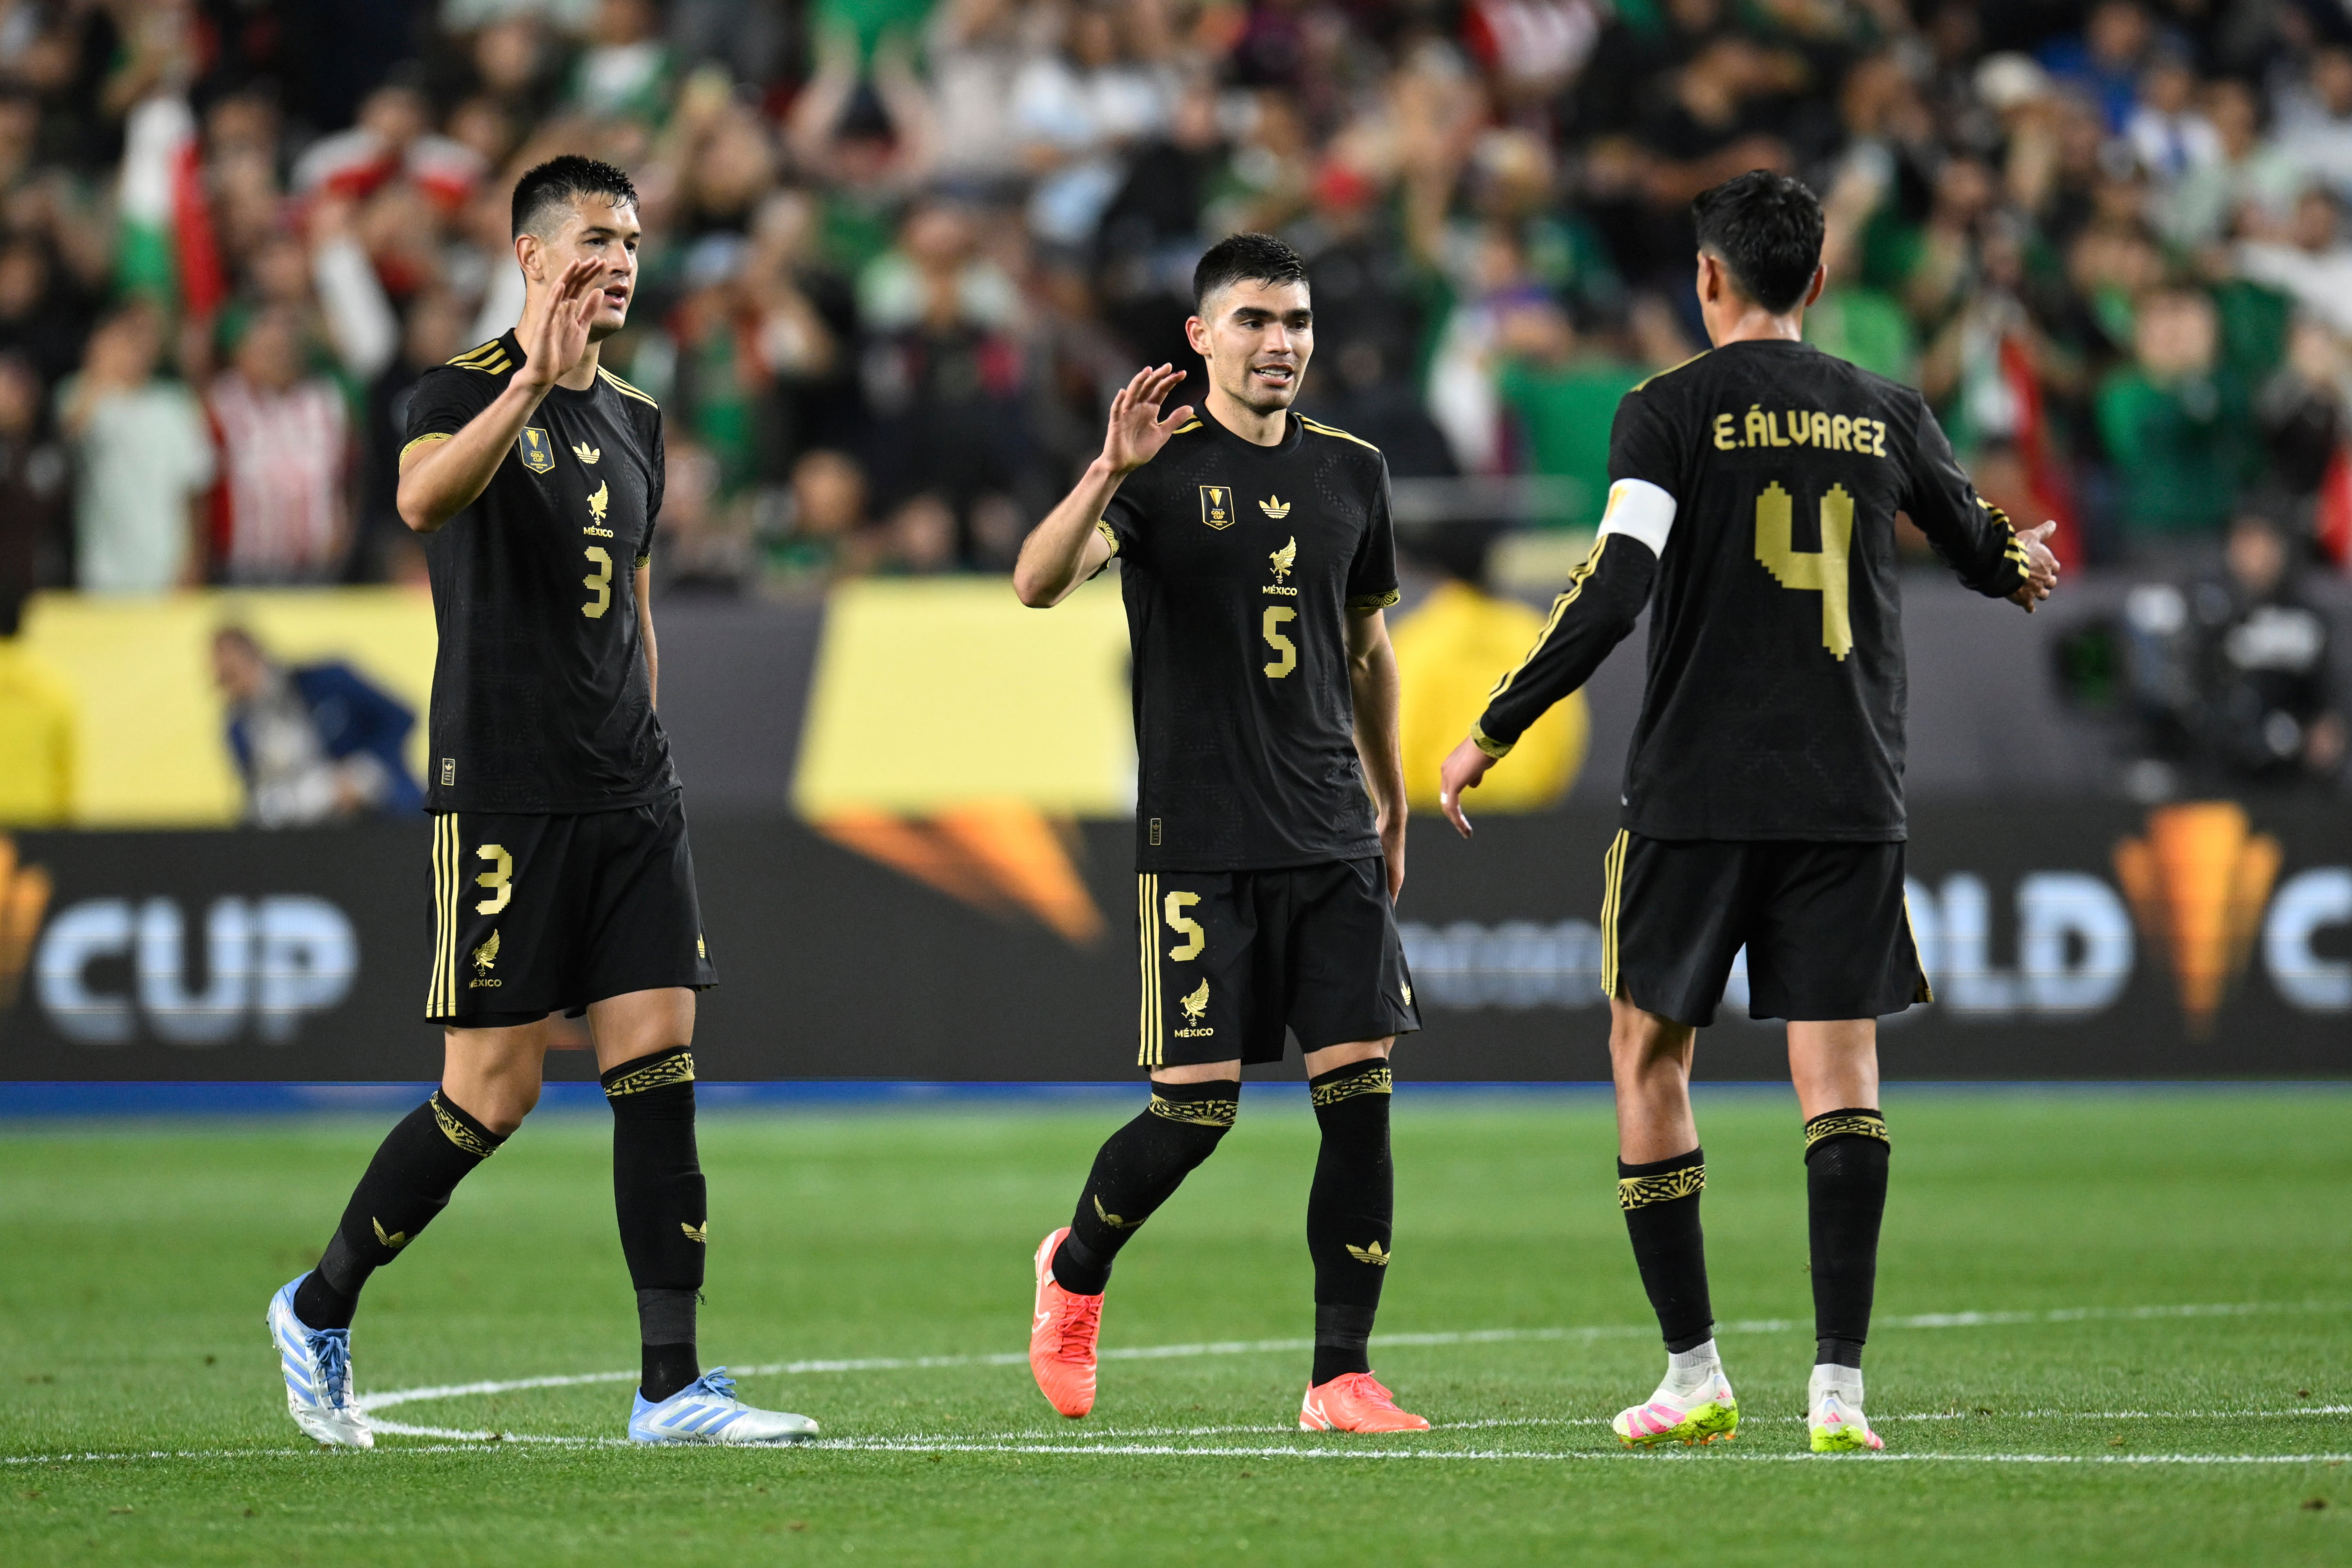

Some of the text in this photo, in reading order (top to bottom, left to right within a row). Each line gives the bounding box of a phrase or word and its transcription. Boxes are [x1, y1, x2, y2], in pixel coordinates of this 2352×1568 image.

[1713, 404, 1886, 457] E.ÁLVAREZ
[583, 525, 613, 538] MÉXICO
[581, 546, 612, 619] 3
[1263, 584, 1297, 596] MÉXICO
[1755, 480, 1854, 661] 4
[1263, 606, 1297, 678] 5
[475, 844, 512, 915] 3
[1164, 891, 1205, 962] 5
[34, 894, 360, 1045] CUP
[1175, 1027, 1214, 1038] MÉXICO
